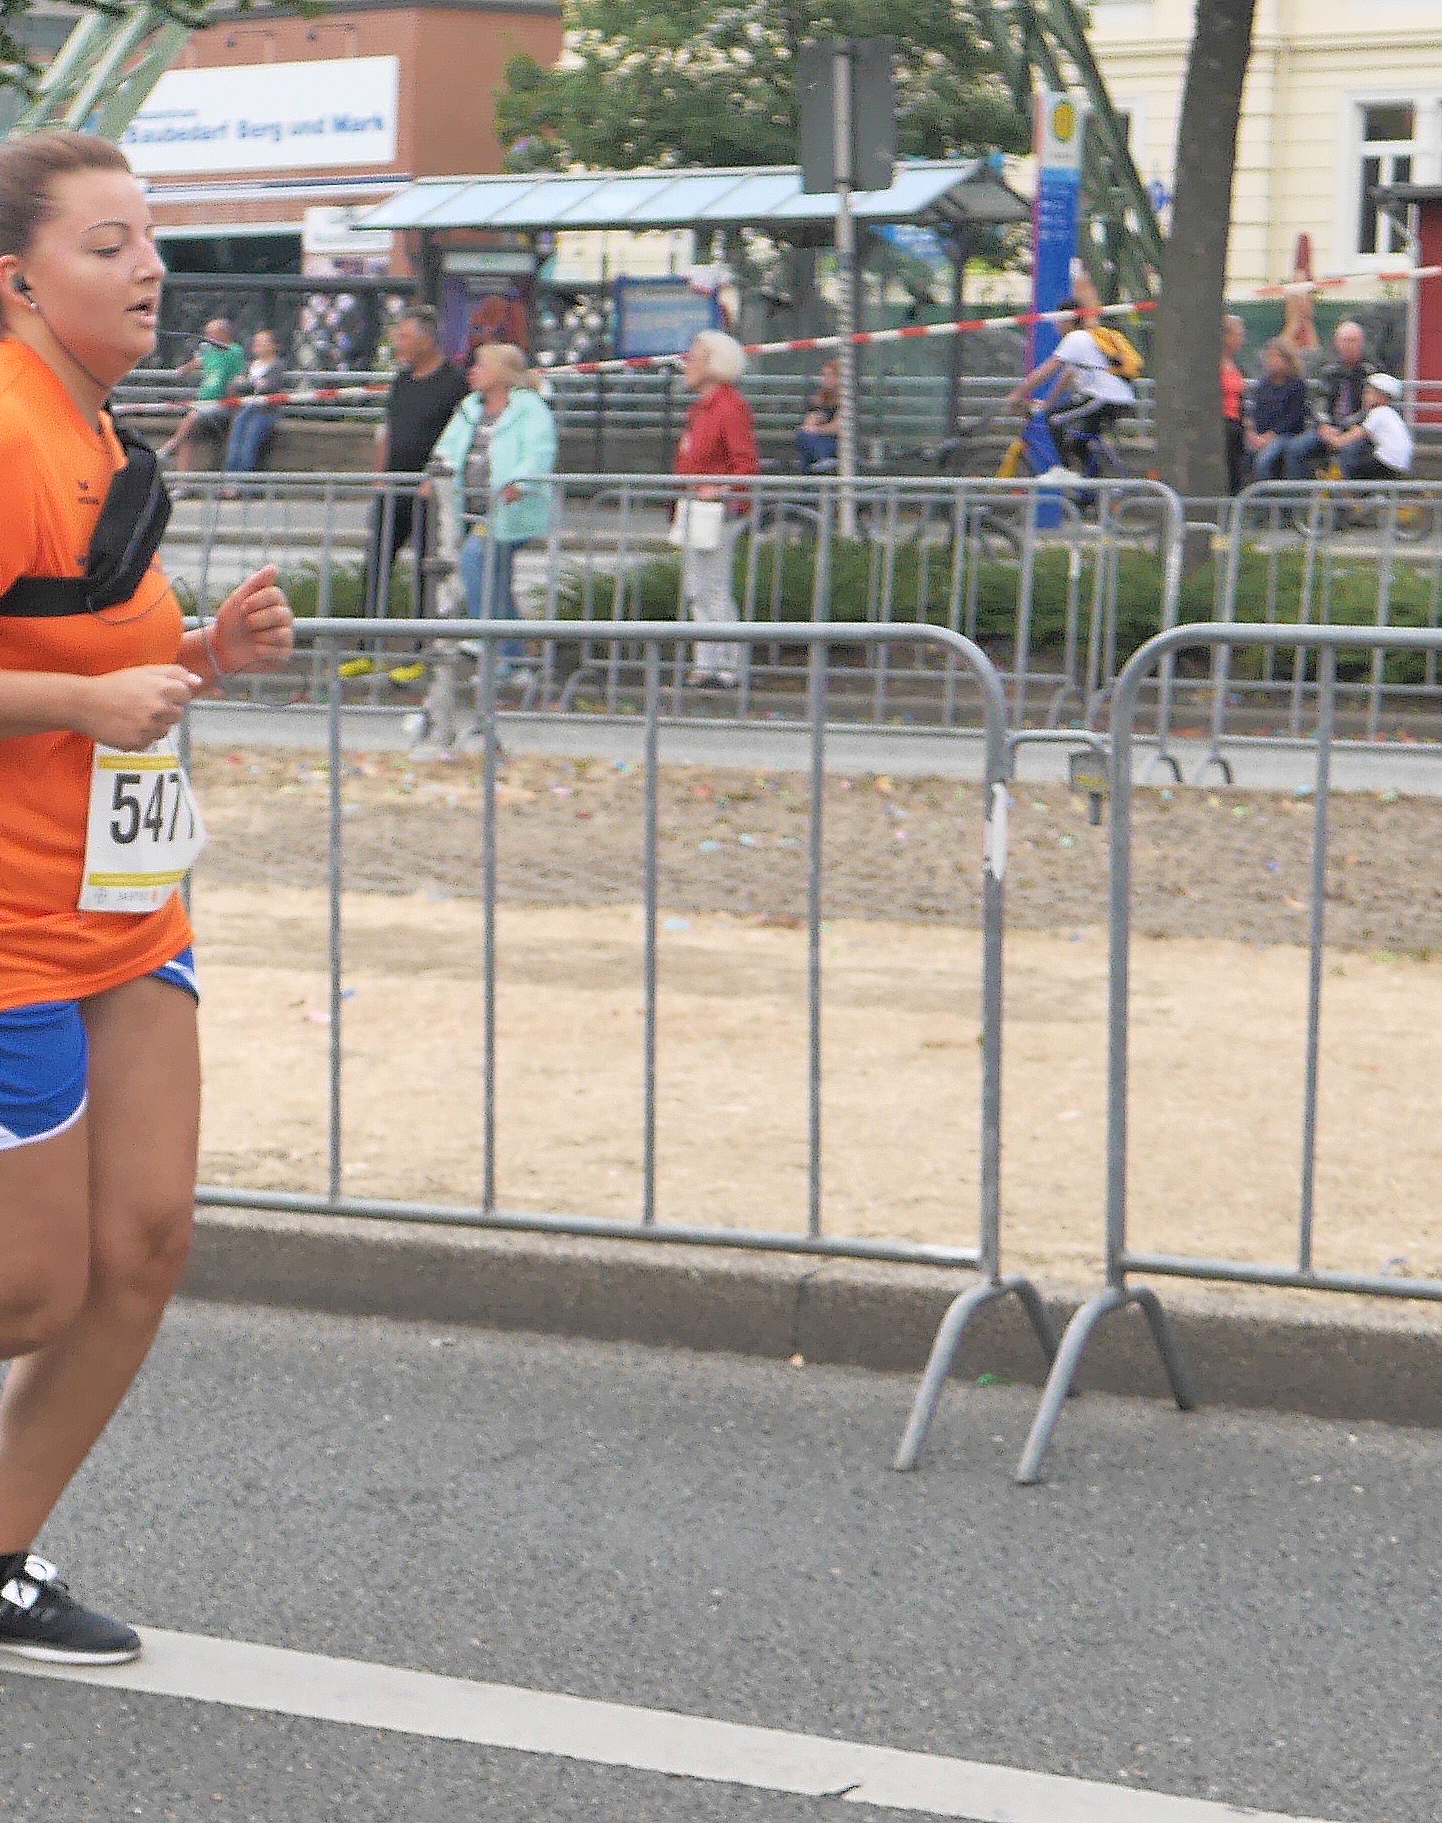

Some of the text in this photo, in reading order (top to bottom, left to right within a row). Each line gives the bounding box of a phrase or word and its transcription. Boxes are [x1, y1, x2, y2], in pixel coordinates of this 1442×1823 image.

[237, 118, 281, 143] Berg
[290, 118, 324, 136] und
[332, 111, 384, 133] Mark
